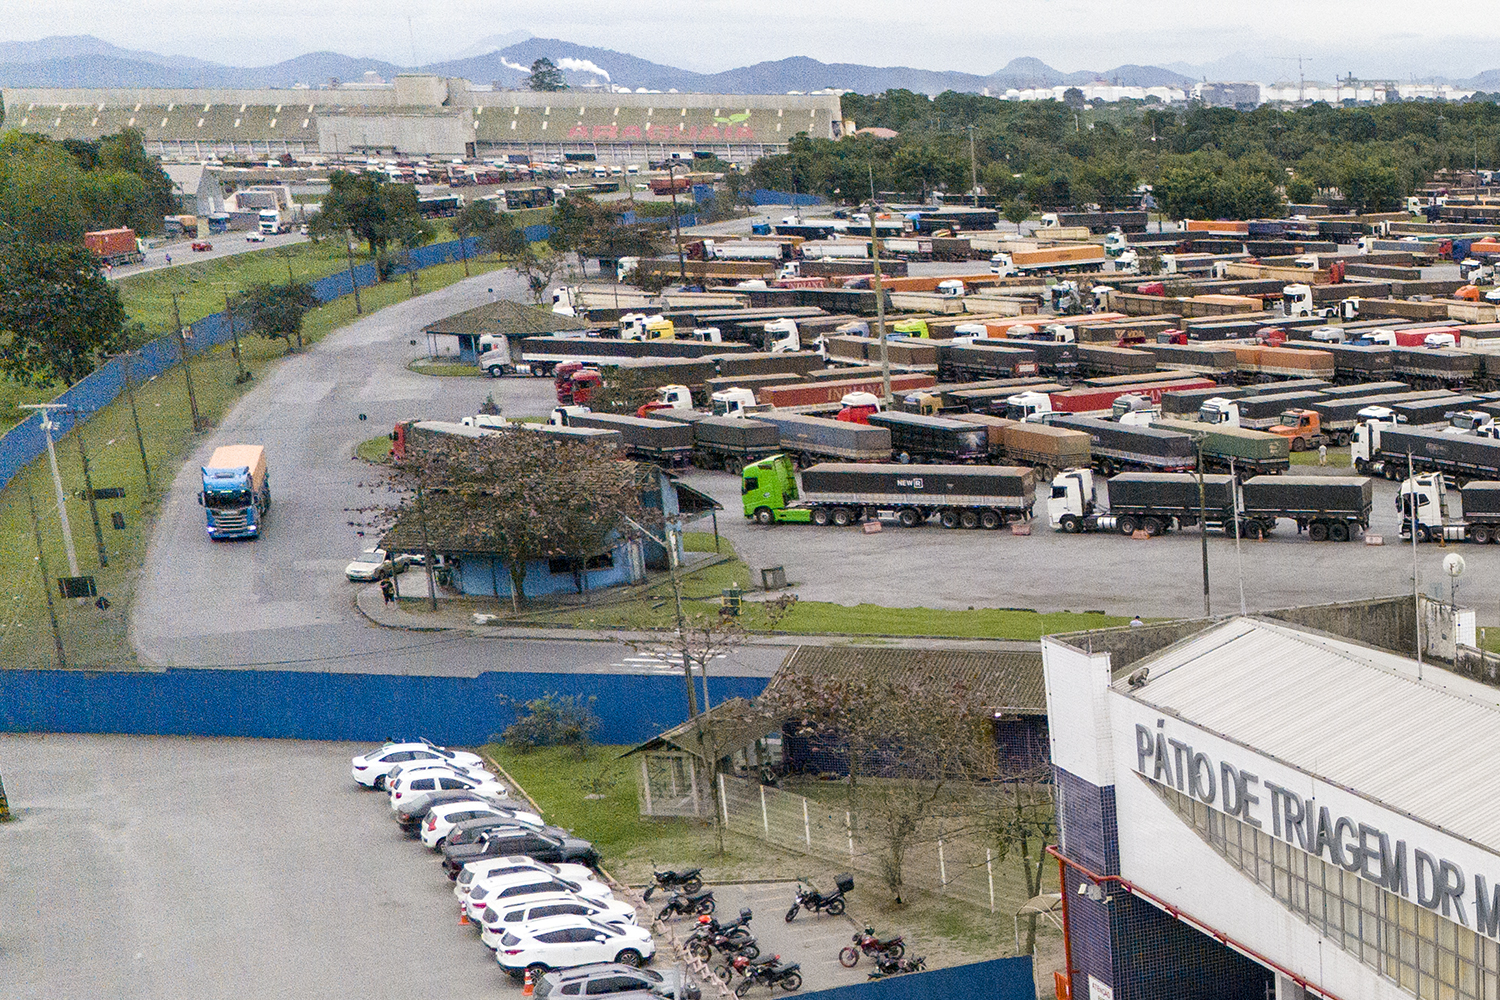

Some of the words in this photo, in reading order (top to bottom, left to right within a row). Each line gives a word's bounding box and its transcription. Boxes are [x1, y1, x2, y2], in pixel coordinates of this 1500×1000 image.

[567, 125, 753, 139] ARAGUAIA
[897, 479, 913, 487] NEW
[1135, 718, 1217, 804] PÁTIO
[1220, 760, 1262, 828] DE
[1264, 779, 1409, 897] TRIAGEM
[1415, 846, 1469, 927] DR
